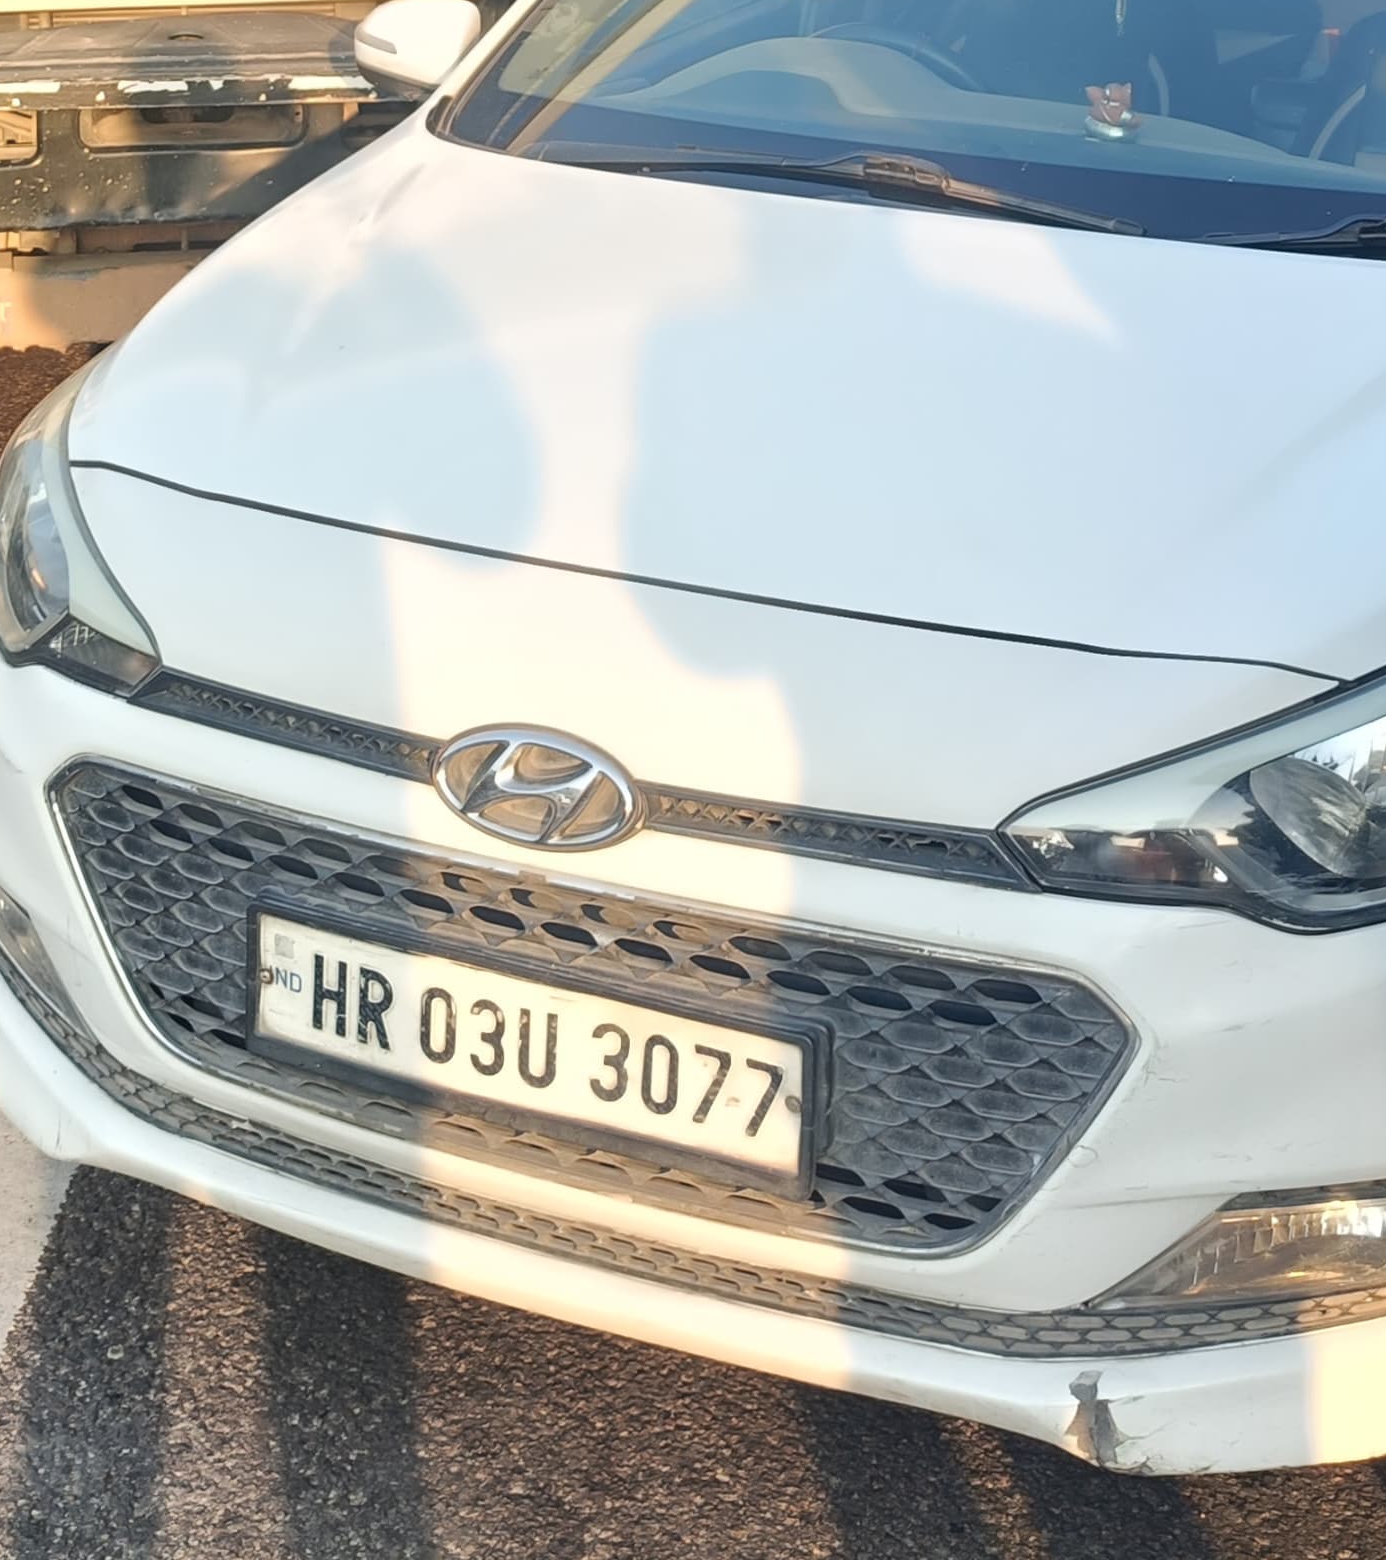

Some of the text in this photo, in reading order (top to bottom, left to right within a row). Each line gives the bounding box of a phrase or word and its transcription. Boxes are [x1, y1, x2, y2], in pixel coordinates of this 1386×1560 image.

[312, 953, 785, 1139] HR 03U 3077
